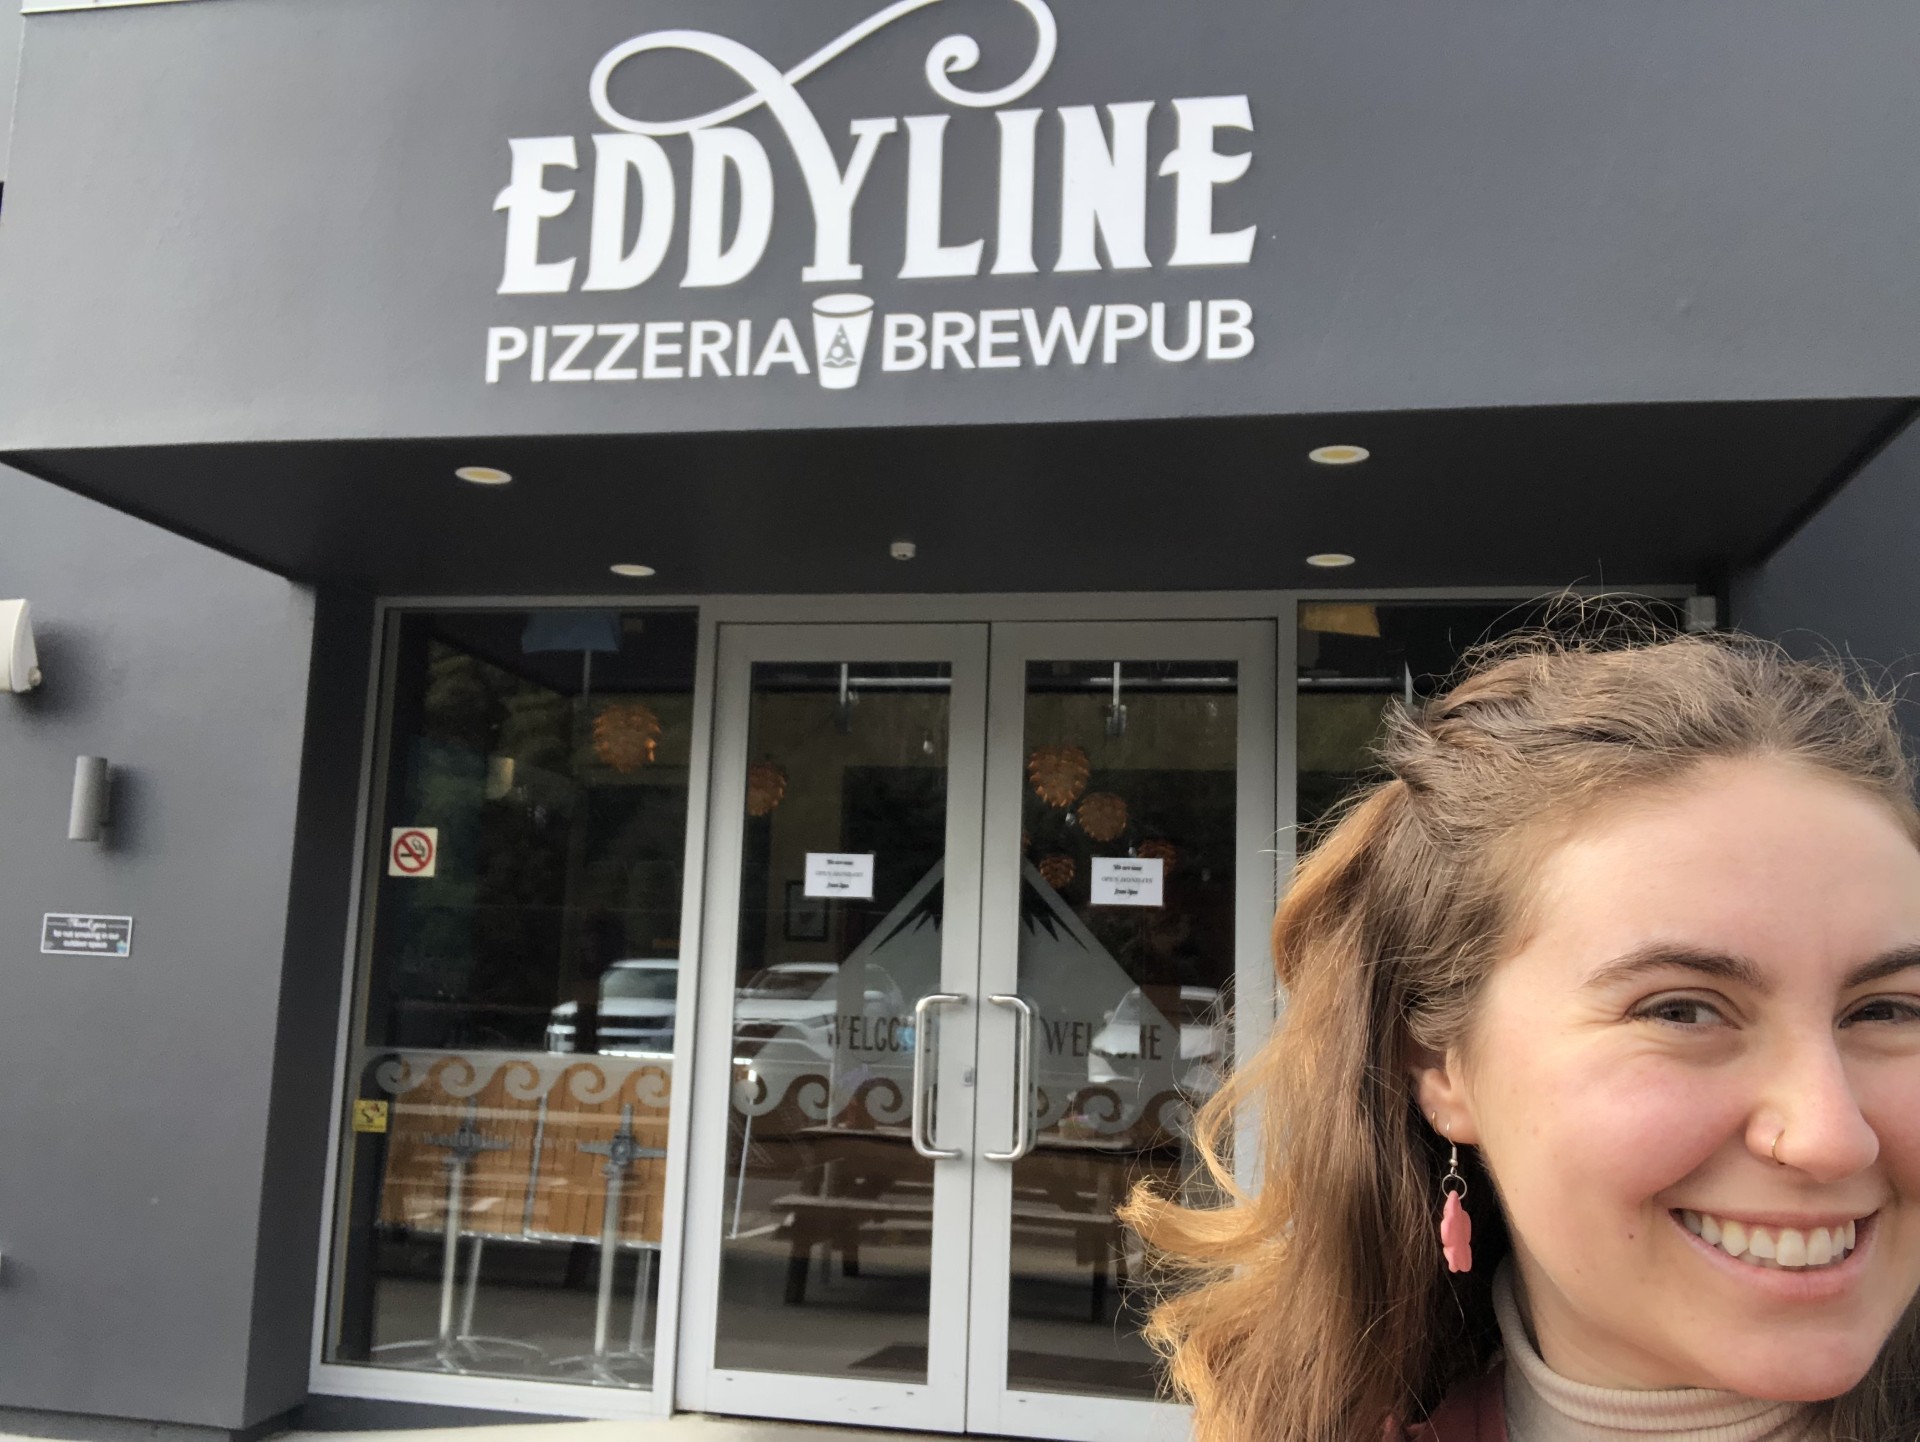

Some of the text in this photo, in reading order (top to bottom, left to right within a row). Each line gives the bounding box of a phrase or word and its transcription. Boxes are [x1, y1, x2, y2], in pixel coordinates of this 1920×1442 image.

[493, 94, 1257, 295] EDDYLINE
[484, 299, 1256, 386] PIZZERIA BREWPUB
